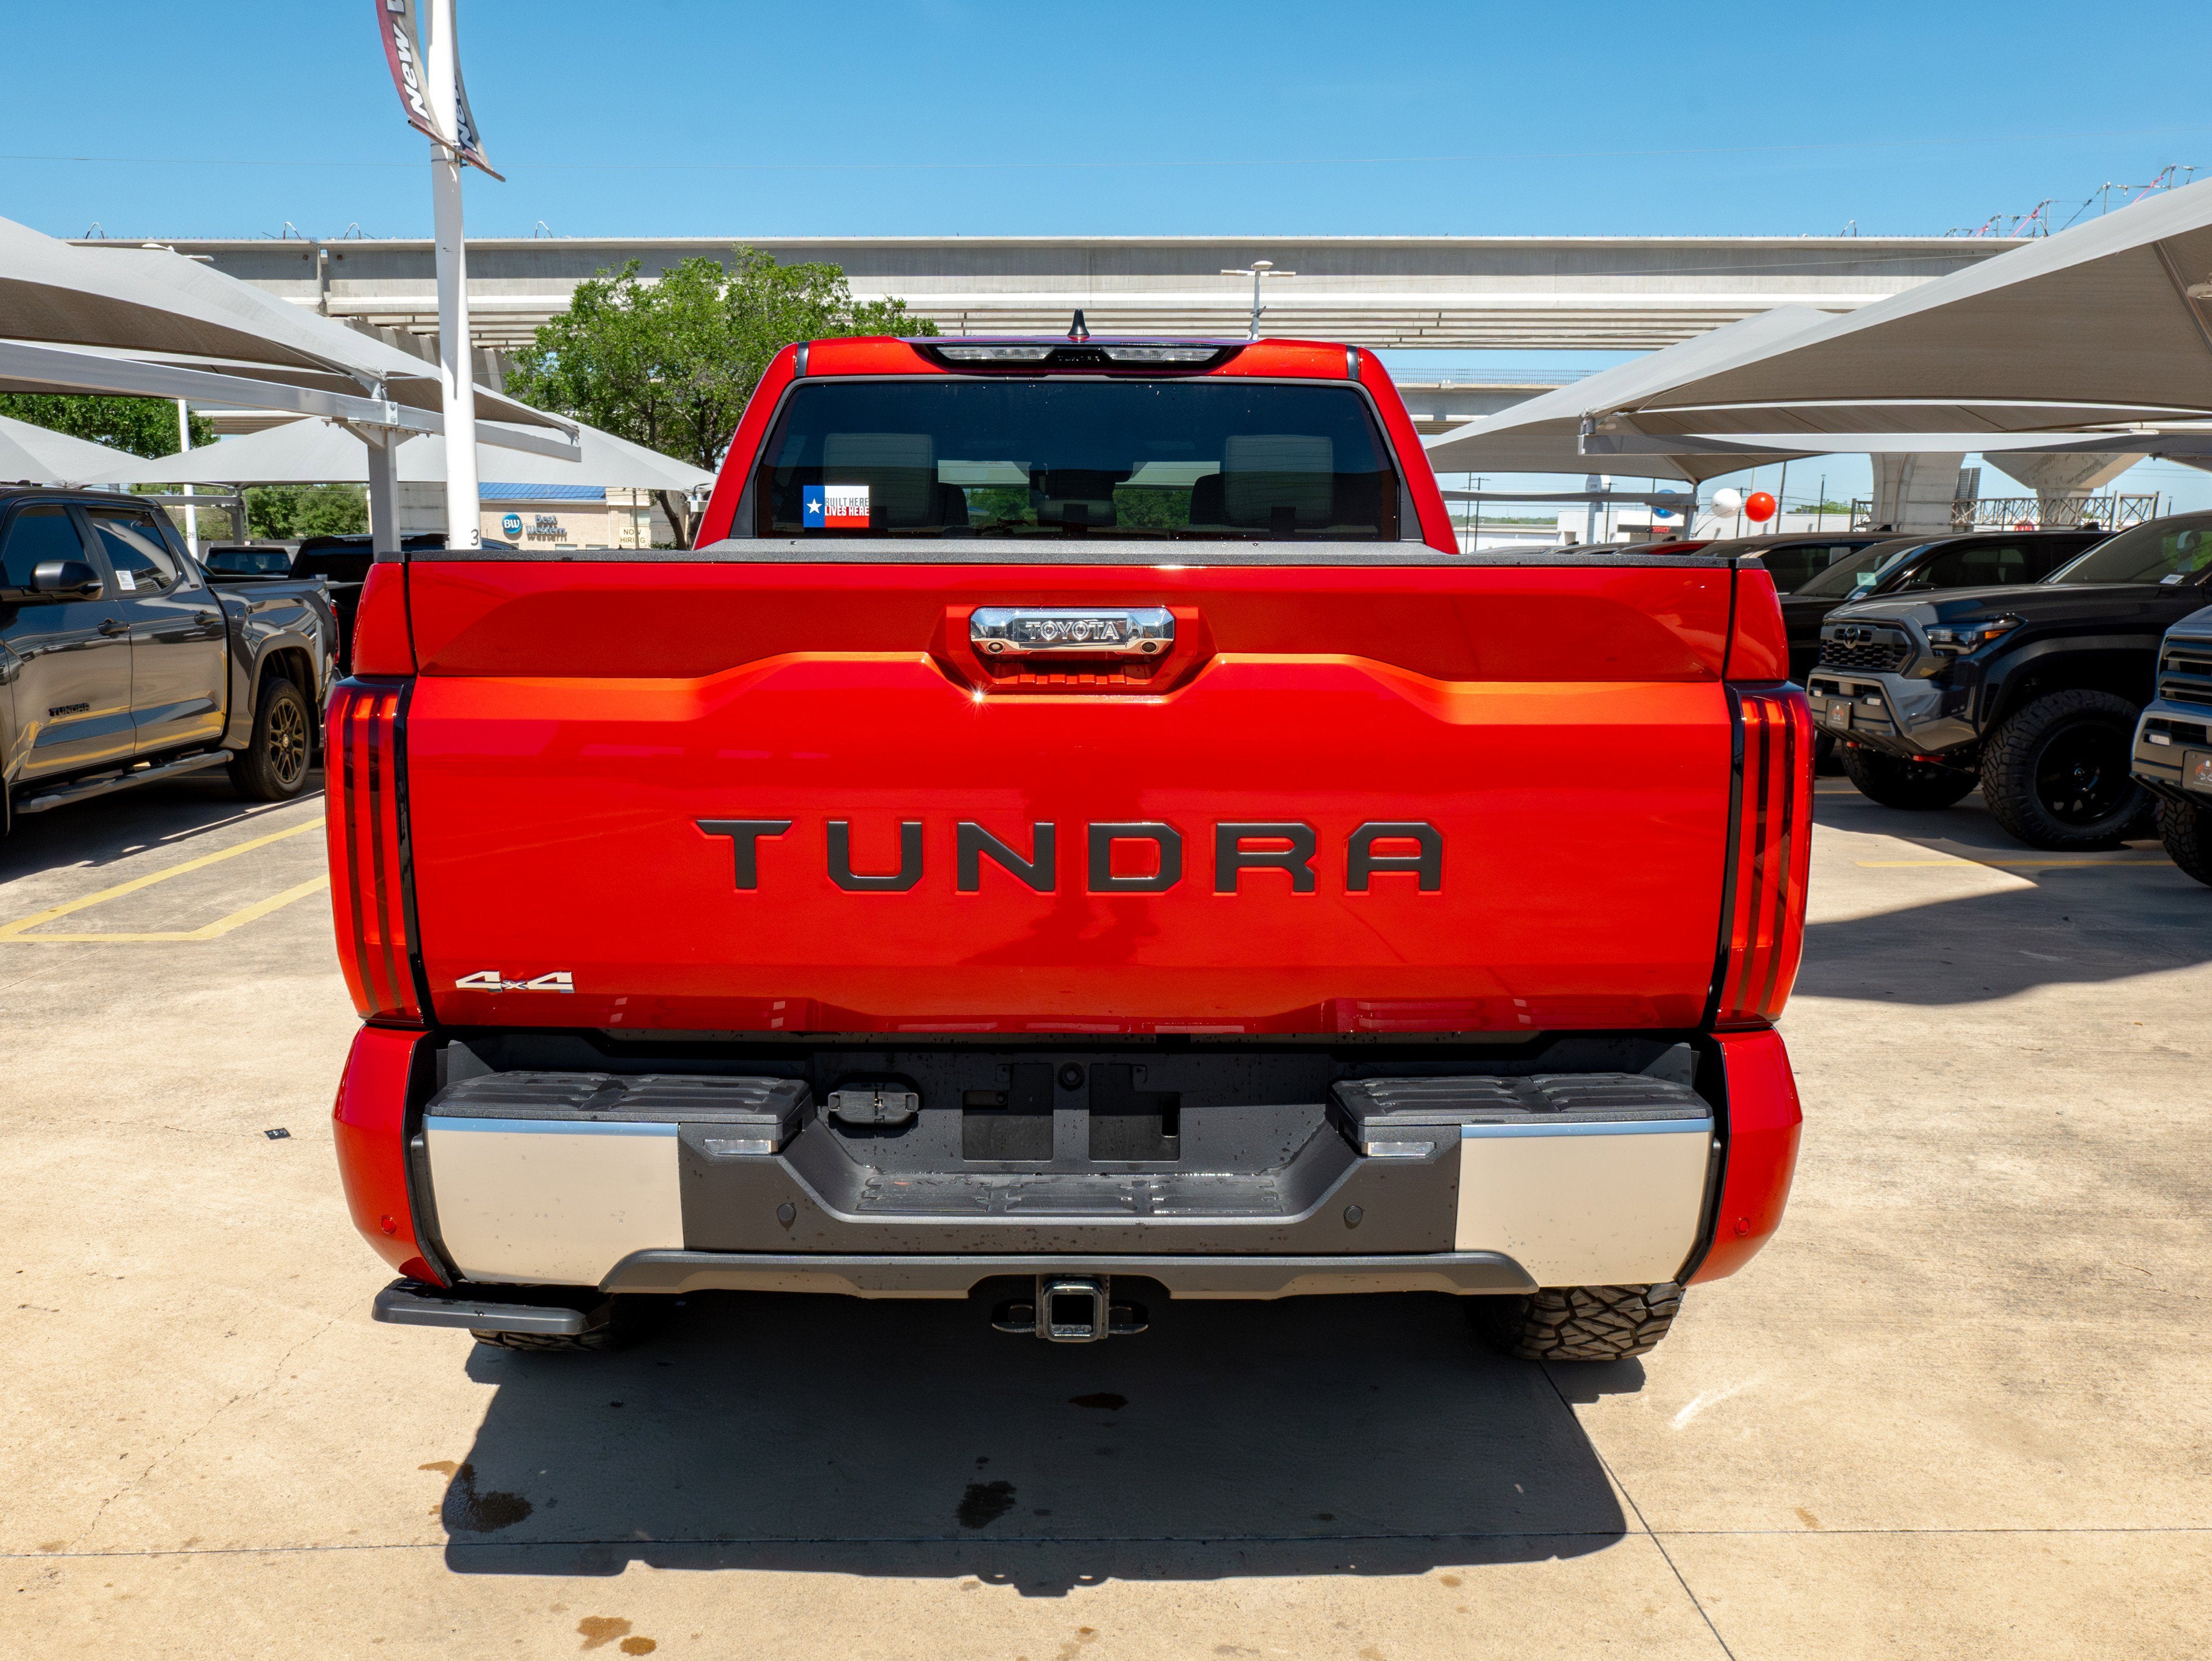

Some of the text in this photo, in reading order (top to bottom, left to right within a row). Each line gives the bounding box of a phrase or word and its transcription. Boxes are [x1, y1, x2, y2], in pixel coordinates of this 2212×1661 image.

[393, 22, 430, 121] New
[825, 497, 869, 507] BUILT HERE
[825, 506, 869, 516] LIVES HERE
[504, 519, 520, 528] BW
[535, 514, 556, 523] Best
[471, 528, 479, 546] 3
[525, 525, 566, 535] Western
[1025, 620, 1120, 641] TOYOTA
[694, 818, 1444, 895] TUNDRA
[455, 970, 575, 994] 4x4
